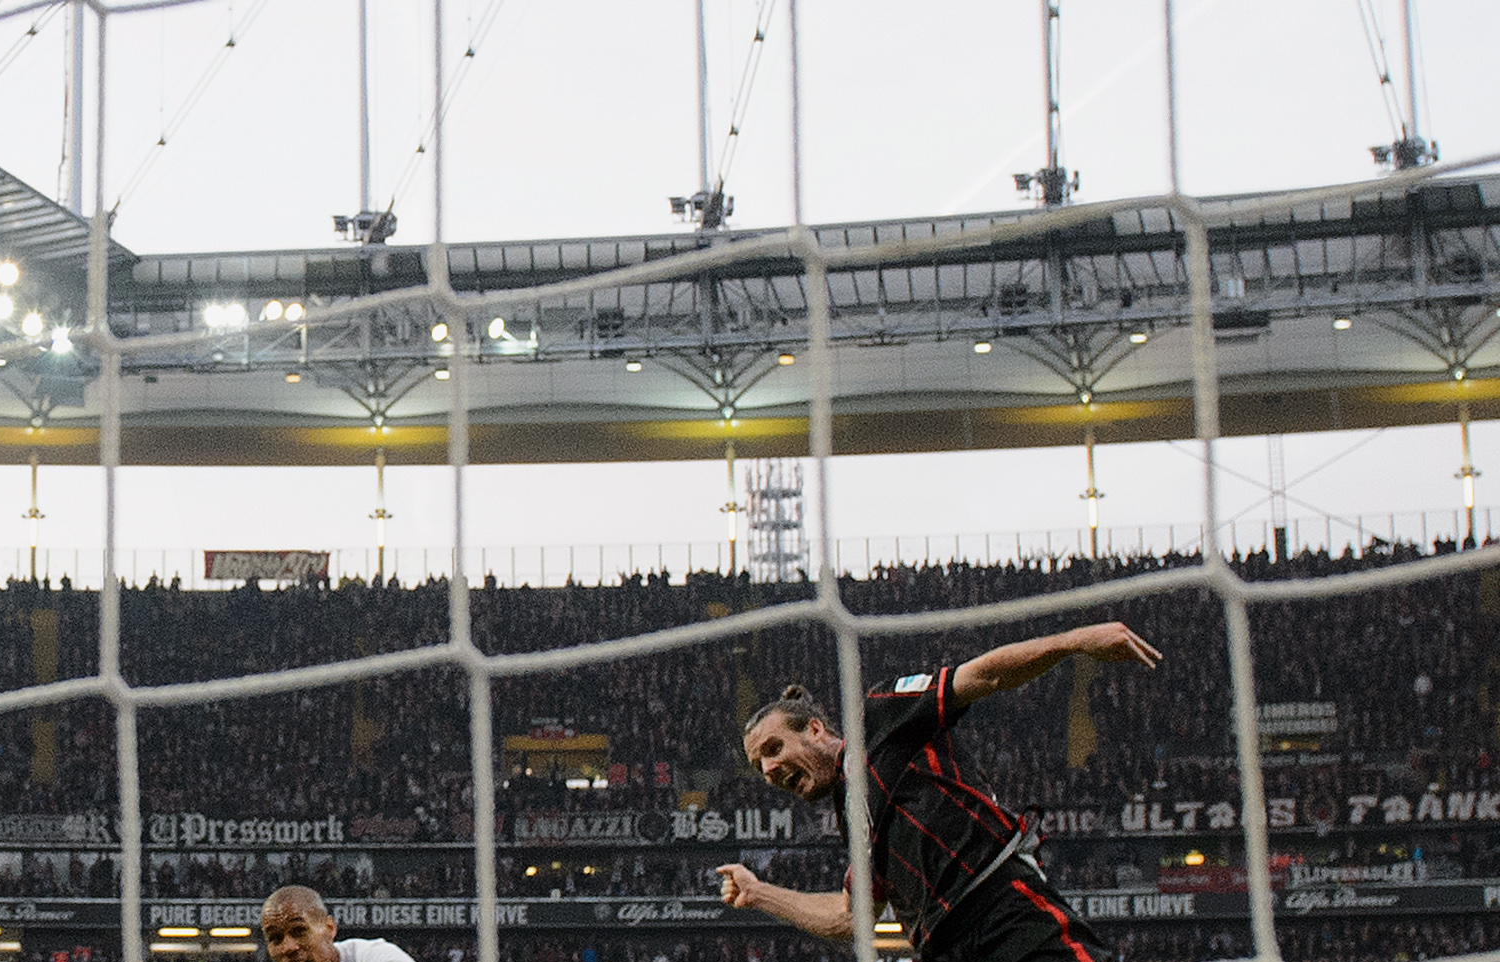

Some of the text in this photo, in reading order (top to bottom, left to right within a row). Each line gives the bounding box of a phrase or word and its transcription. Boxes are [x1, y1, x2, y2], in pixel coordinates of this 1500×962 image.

[1121, 797, 1298, 832] ULTRS
[150, 905, 197, 926] PURE
[200, 906, 263, 927] BEGEIS
[371, 905, 424, 926] DIESE
[426, 905, 469, 926] EINE
[470, 904, 529, 926] KRVE
[1086, 895, 1130, 917] EINE
[1133, 893, 1197, 916] KURVE
